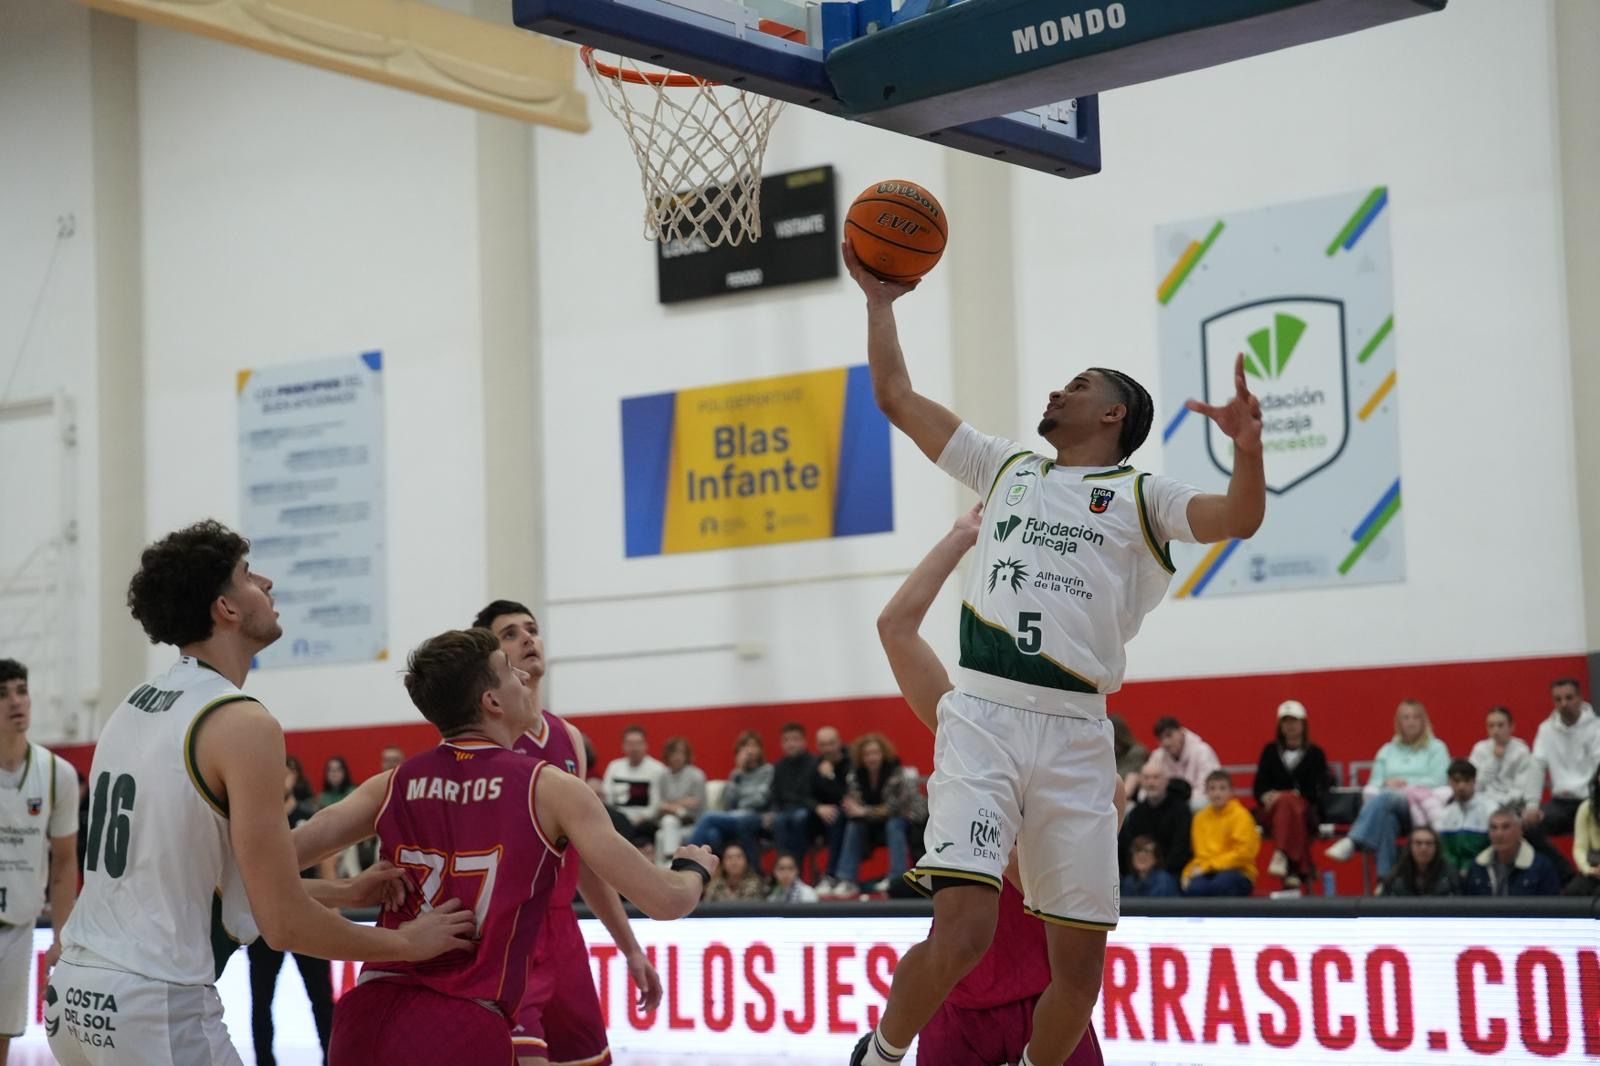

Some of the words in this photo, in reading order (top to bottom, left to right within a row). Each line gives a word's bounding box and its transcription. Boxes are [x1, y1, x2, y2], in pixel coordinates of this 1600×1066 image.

[1012, 3, 1126, 54] MONDO
[877, 212, 921, 235] EVO
[714, 424, 790, 459] Blas
[687, 460, 820, 502] Infante
[1093, 488, 1112, 497] LIGA
[1022, 531, 1078, 556] Unicaja
[1025, 517, 1104, 547] Fundación
[1034, 580, 1049, 590] de
[1050, 583, 1062, 593] la
[1063, 586, 1093, 600] Torre
[1036, 571, 1085, 587] Alhaurín
[1017, 611, 1042, 654] 5
[406, 777, 504, 805] MARTOS
[86, 771, 136, 878] 16
[65, 987, 118, 1013] COSTA
[64, 1007, 80, 1026] DEL
[83, 1013, 116, 1032] SOL
